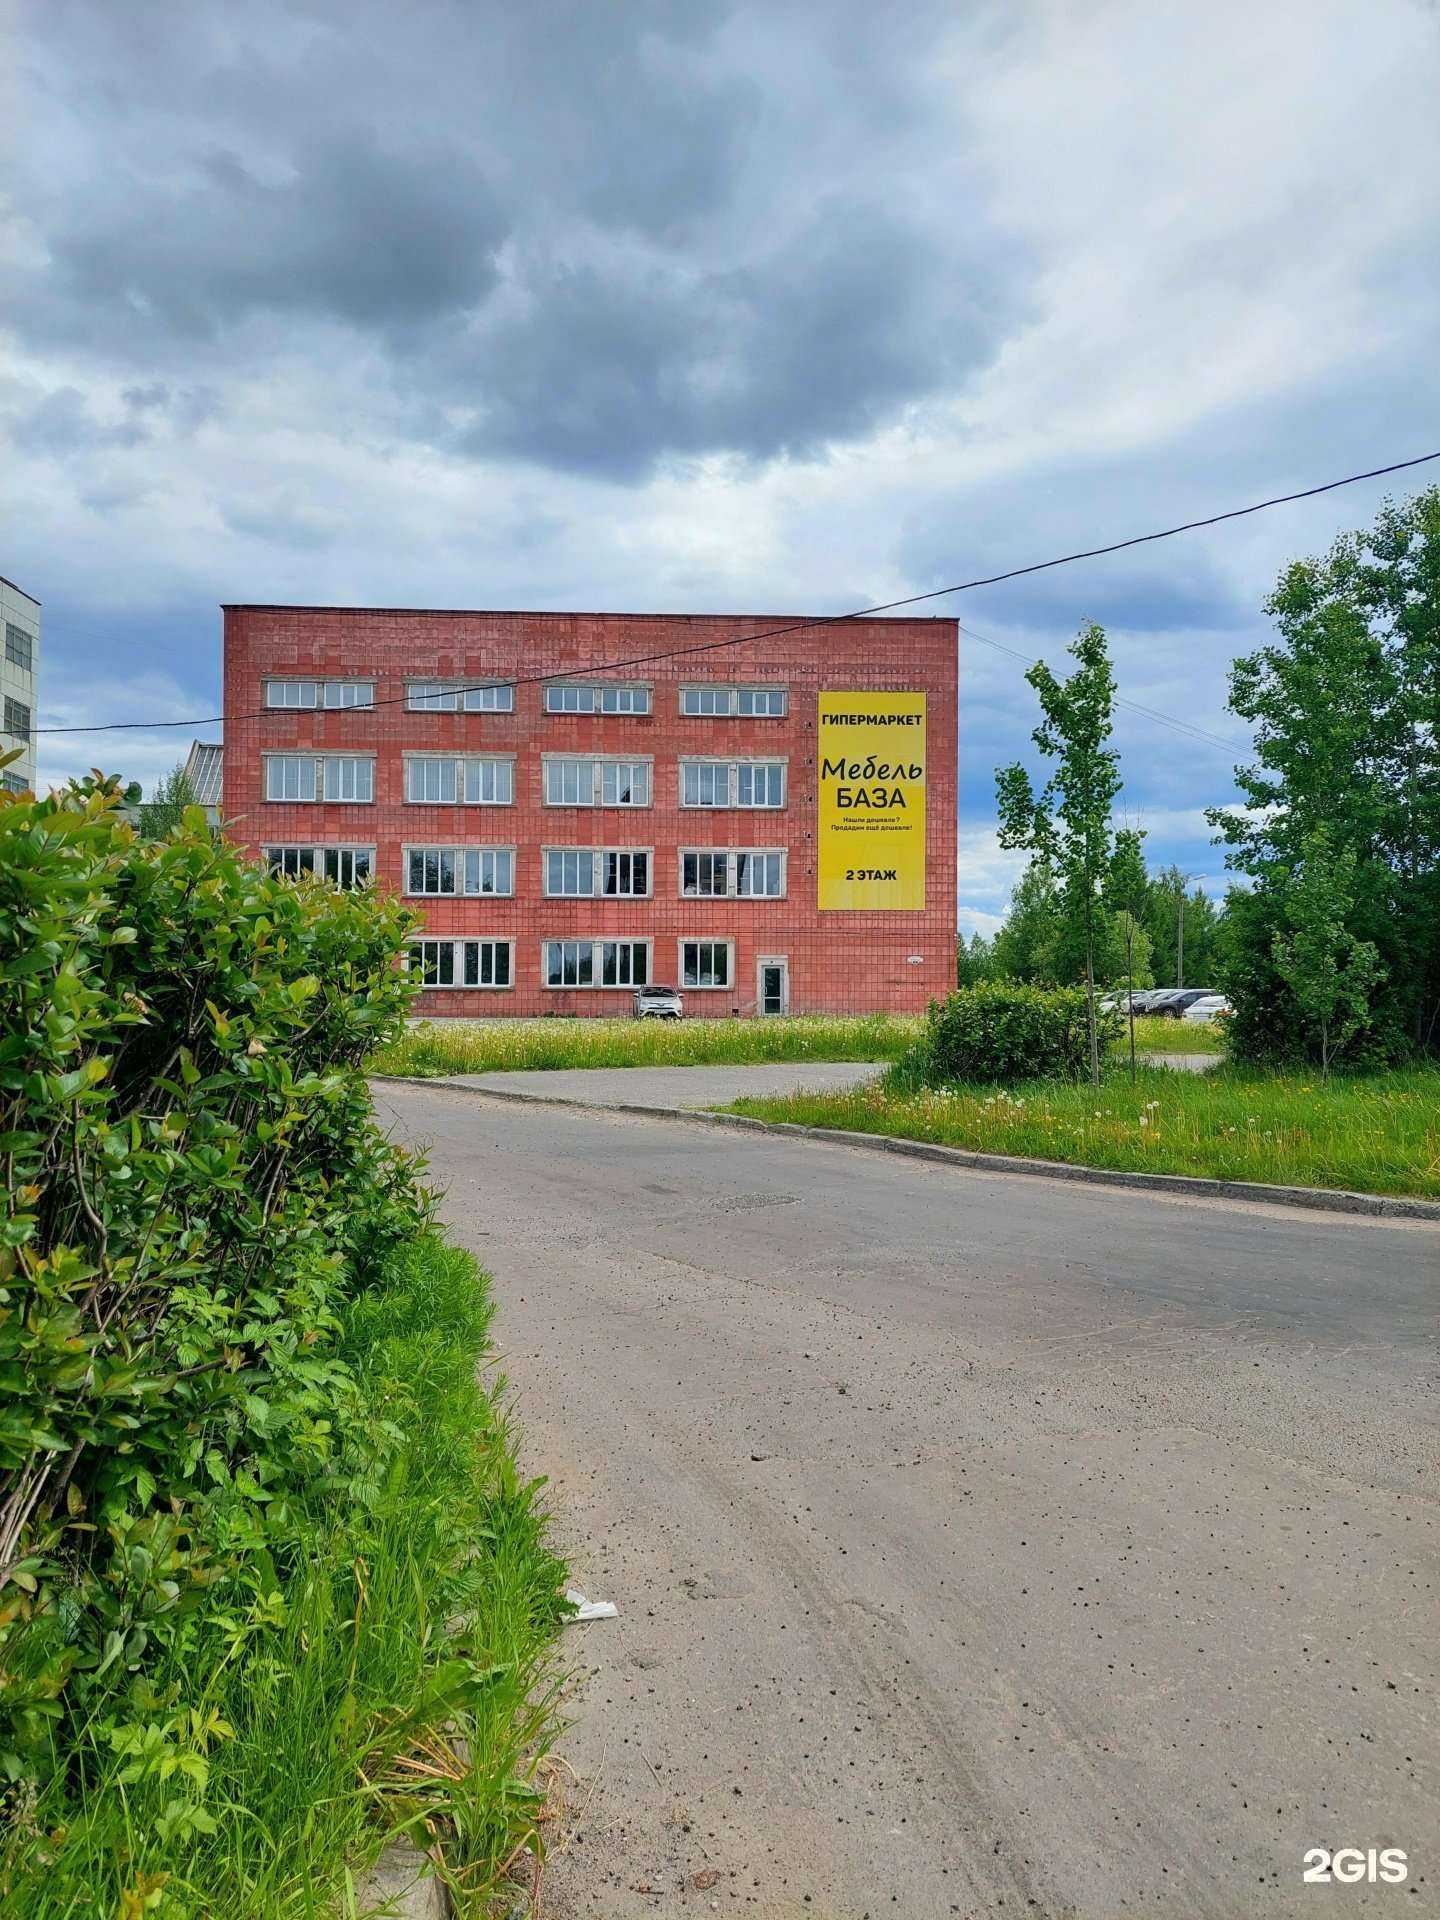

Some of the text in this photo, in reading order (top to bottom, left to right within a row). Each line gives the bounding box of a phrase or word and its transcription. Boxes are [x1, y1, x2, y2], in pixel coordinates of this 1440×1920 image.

[822, 714, 922, 725] ГИПЕРМАРКЕТ
[821, 755, 922, 780] Мебель
[837, 787, 906, 808] БАЗА
[846, 870, 897, 880] 2 ЭТАЖ
